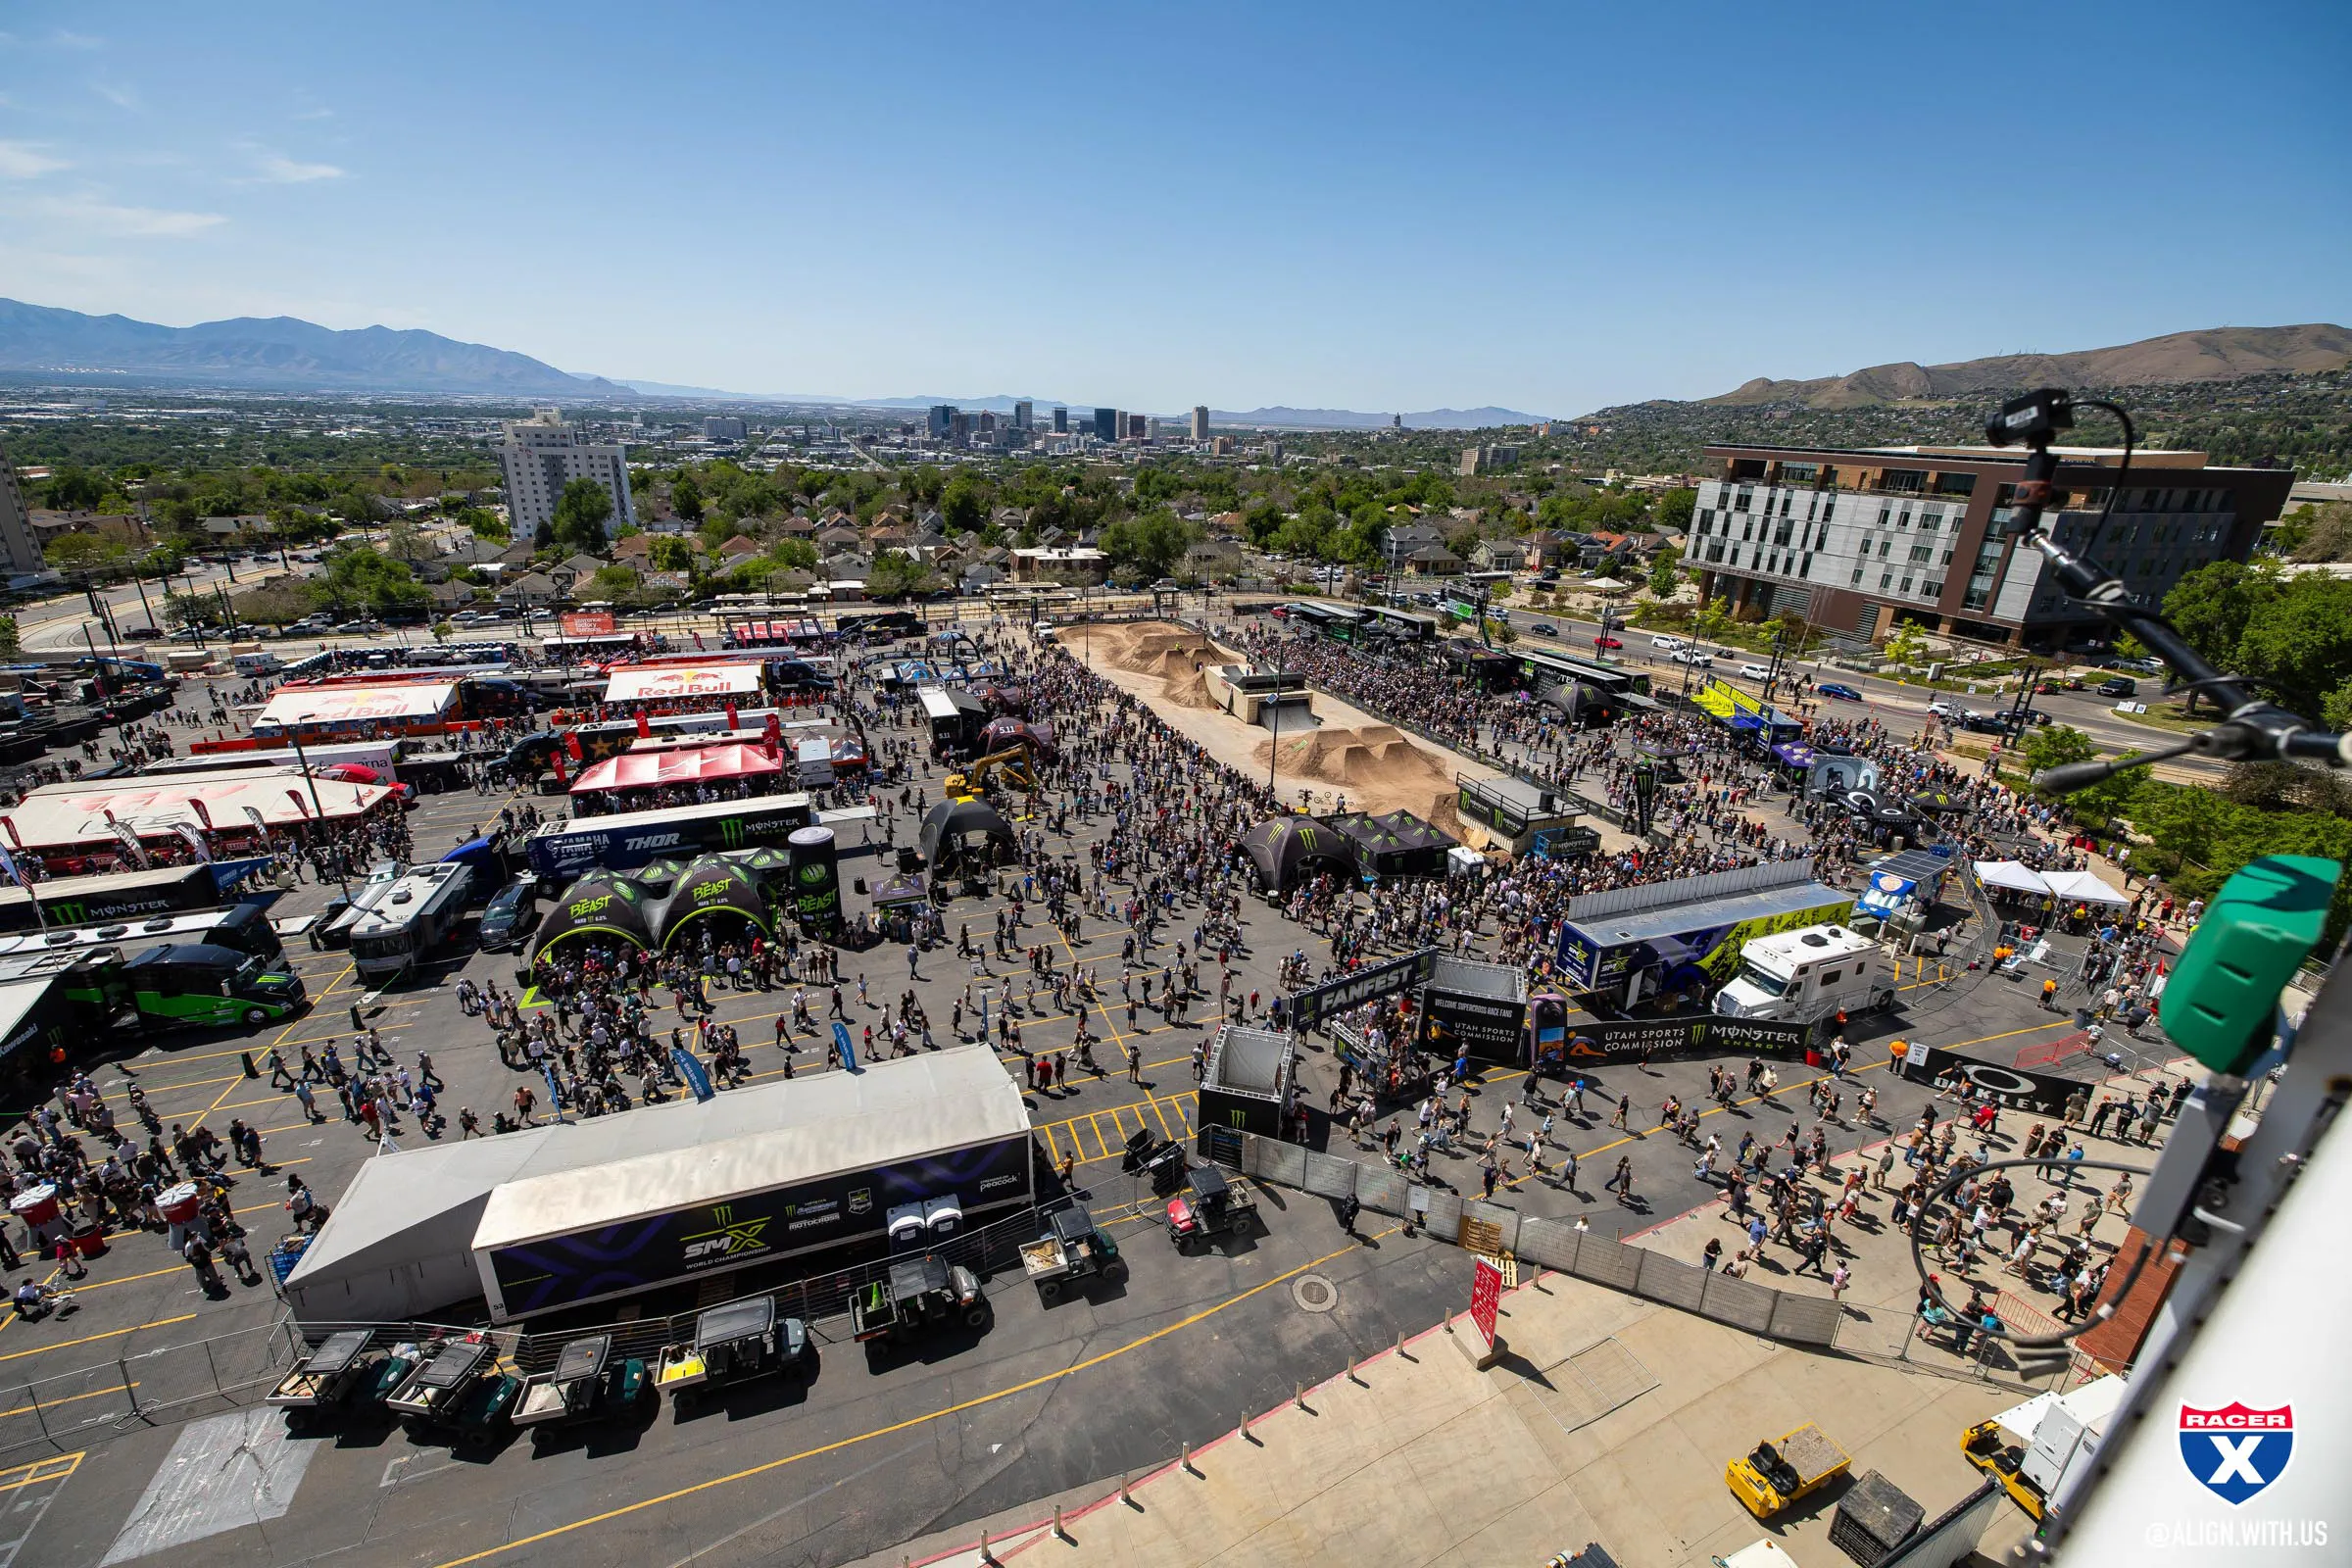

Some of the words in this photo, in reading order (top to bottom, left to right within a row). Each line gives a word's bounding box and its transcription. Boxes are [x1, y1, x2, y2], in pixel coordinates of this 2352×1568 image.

[638, 684, 684, 697] Red
[687, 682, 731, 694] Bull
[353, 704, 409, 718] Bull
[745, 818, 800, 831] MONSTER
[624, 833, 680, 851] THOR
[693, 878, 732, 902] BEAST
[90, 900, 170, 917] MONSTER
[570, 895, 612, 918] BEAST
[798, 887, 838, 912] BEAST
[1321, 964, 1412, 1012] FANFEST
[1435, 998, 1457, 1010] WELCOME
[1456, 1002, 1488, 1015] SUPERCROSS
[1487, 1005, 1499, 1016] RACE
[1499, 1007, 1513, 1018] FANS
[1454, 1022, 1479, 1032] UTAH
[1482, 1026, 1515, 1037] SPORTS
[1454, 1029, 1515, 1044] COMMISSION
[1604, 1031, 1637, 1041] UTAH
[1641, 1027, 1686, 1039] SPORTS
[1711, 1025, 1800, 1044] MONSTER
[0, 1022, 38, 1056] Kawasaki
[1604, 1038, 1685, 1052] COMMISION
[1723, 1039, 1785, 1051] ENERGY
[1935, 1076, 2050, 1112] OKLEY
[980, 1175, 1018, 1193] peacock
[789, 1212, 840, 1231] MOTOCROSS
[683, 1223, 767, 1259] SMX
[686, 1259, 713, 1270] WORLD
[714, 1246, 771, 1263] CHAMPIONSHIP
